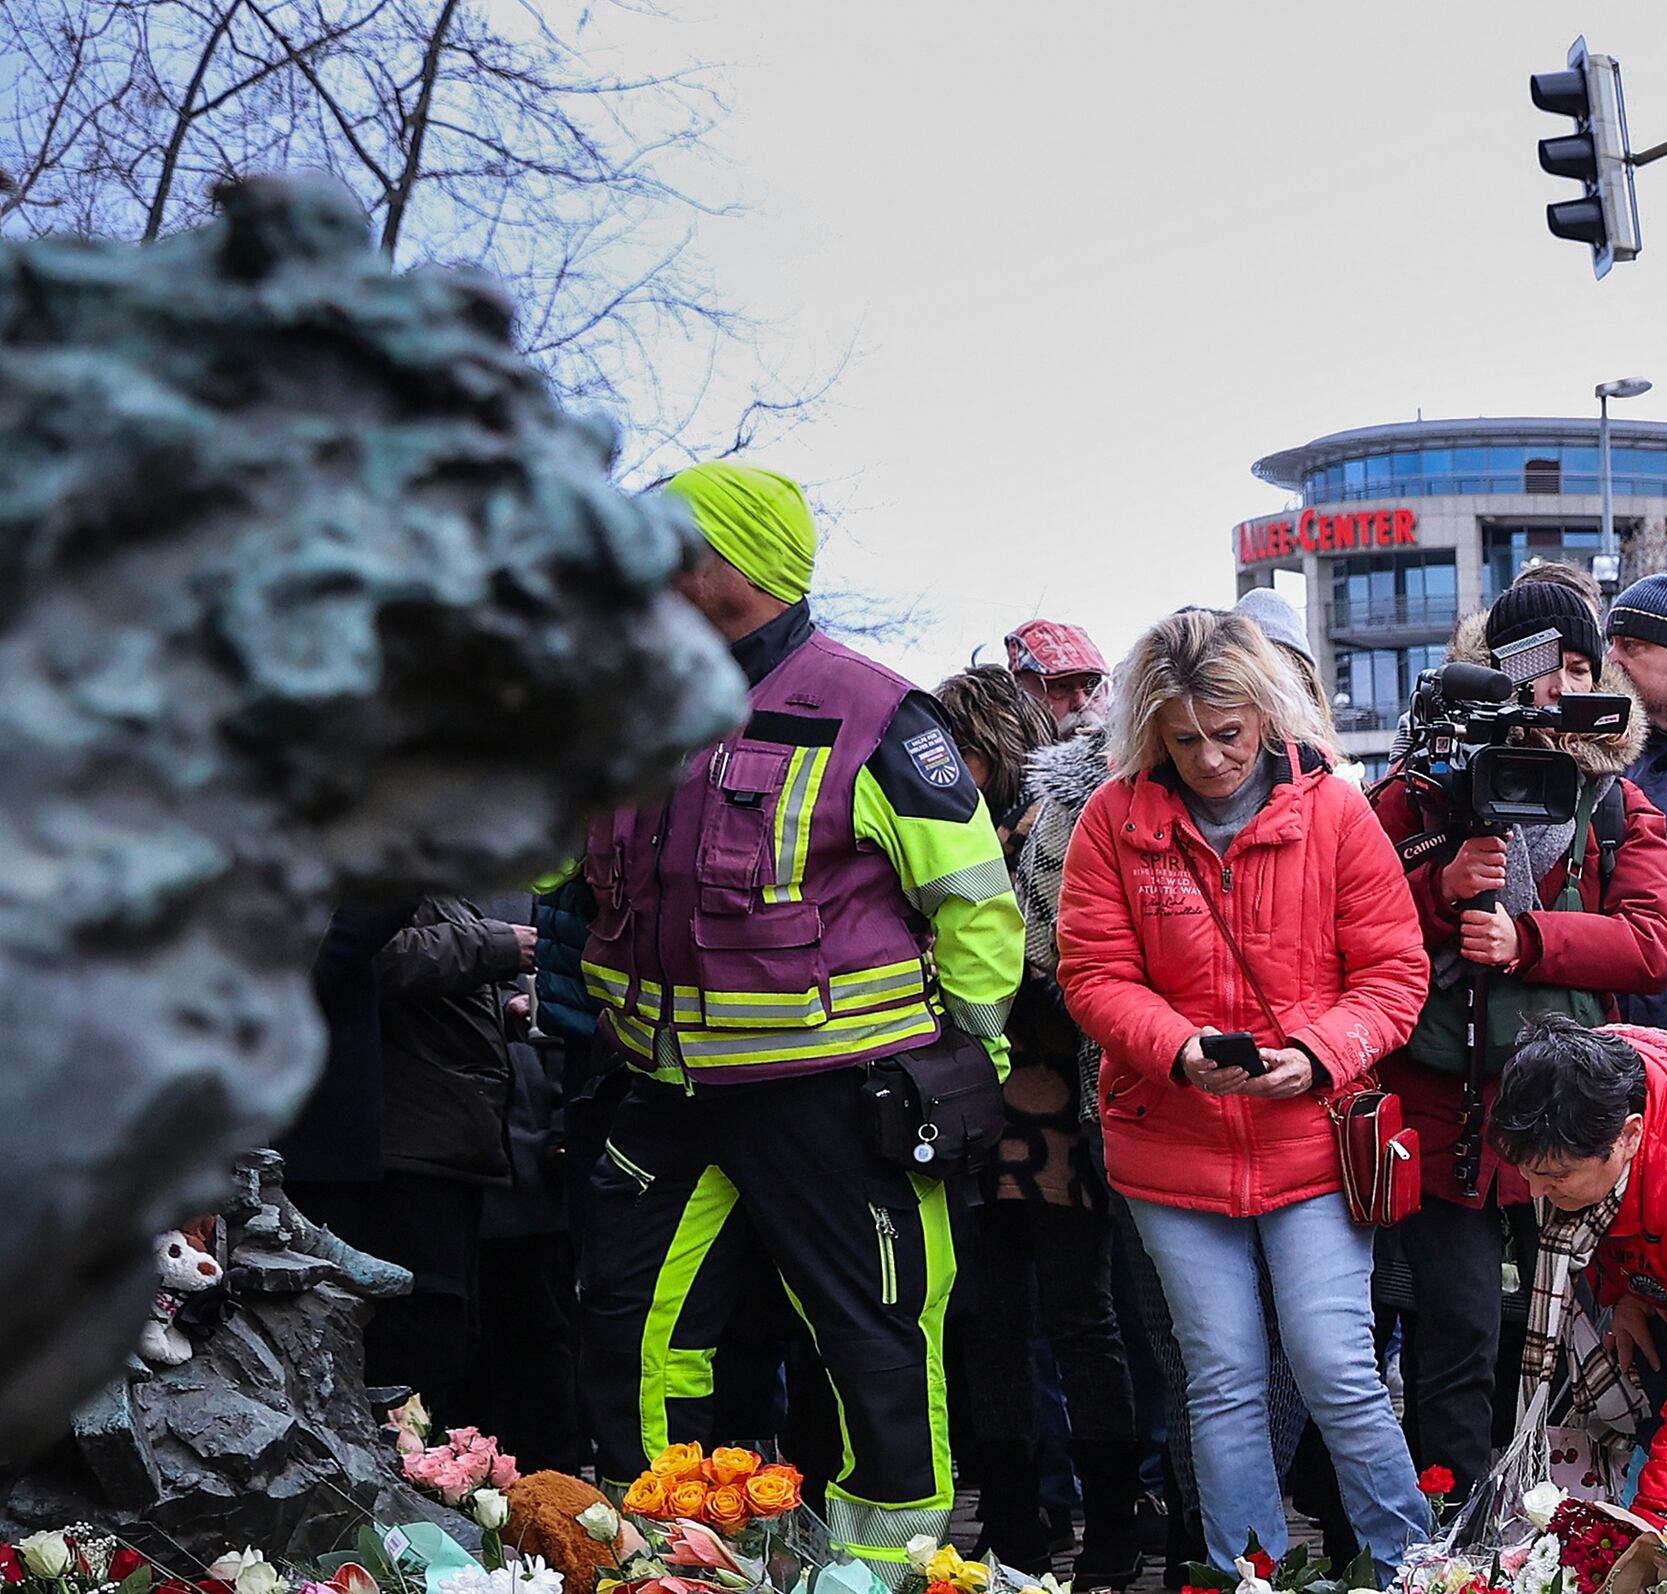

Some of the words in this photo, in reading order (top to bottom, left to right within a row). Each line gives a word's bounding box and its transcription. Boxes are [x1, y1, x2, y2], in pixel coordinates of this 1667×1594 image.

[1240, 507, 1417, 564] ALLEE-CENTER
[1403, 833, 1447, 860] Canon
[1139, 852, 1197, 872] SPIRI
[1180, 887, 1201, 896] WAY
